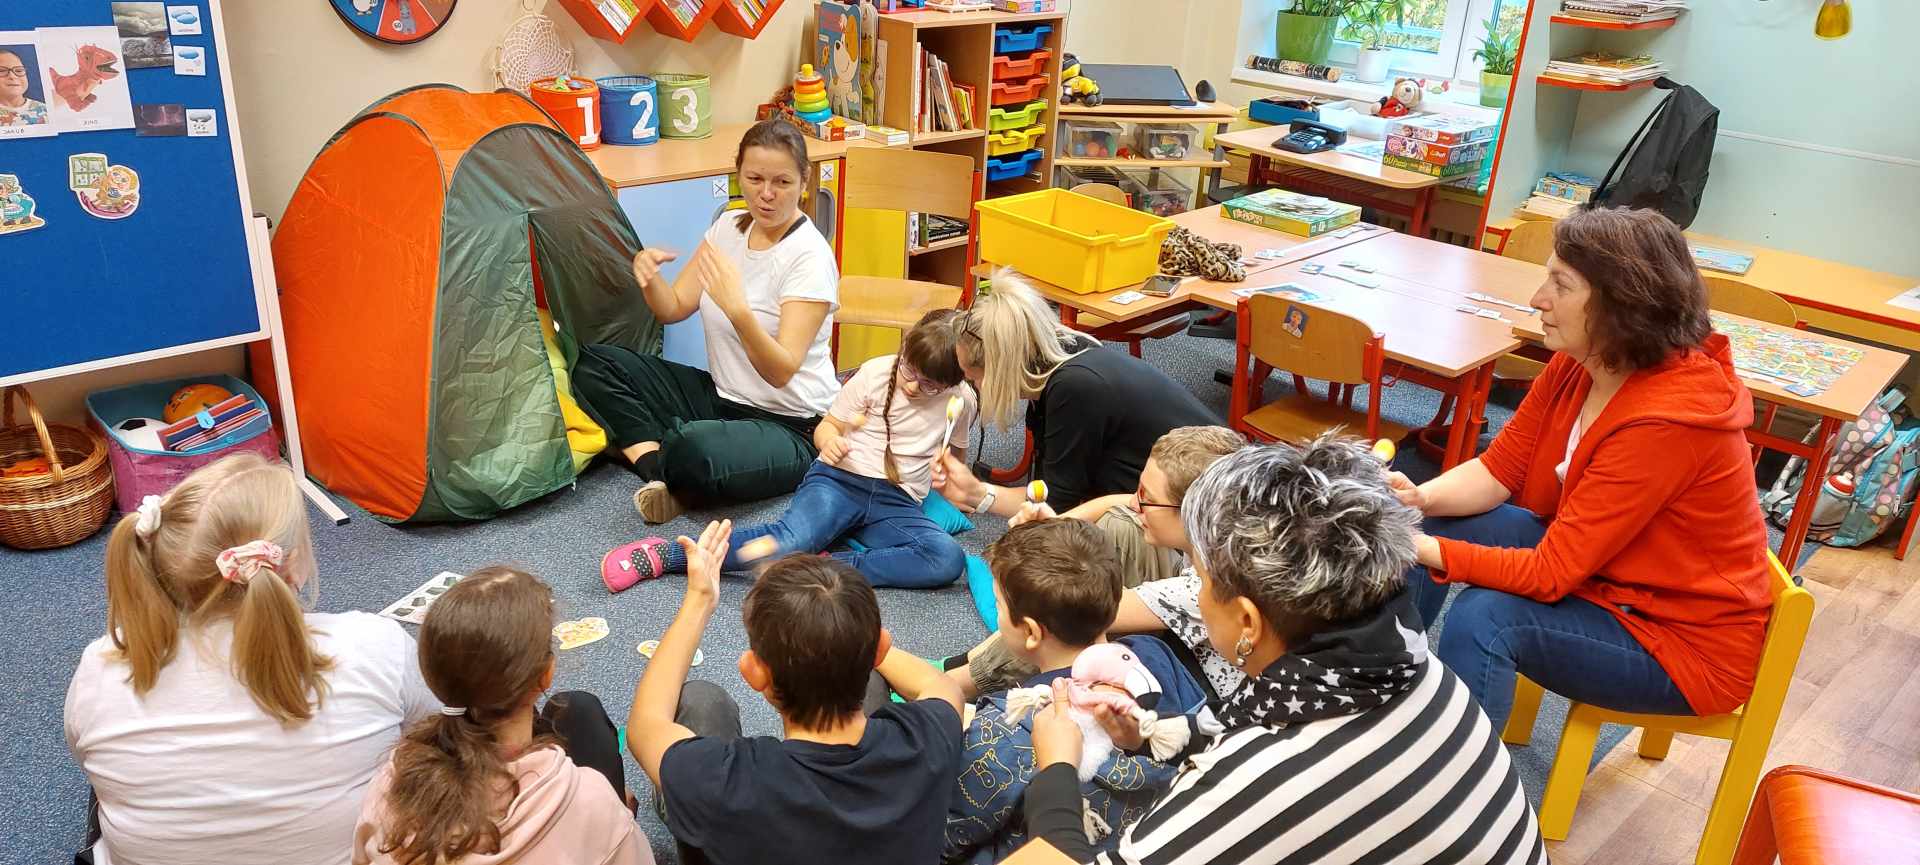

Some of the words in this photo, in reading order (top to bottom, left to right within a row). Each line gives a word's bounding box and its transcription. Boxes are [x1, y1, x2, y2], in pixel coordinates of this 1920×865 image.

[577, 97, 598, 144] 1
[630, 91, 656, 140] 2
[671, 88, 699, 133] 3
